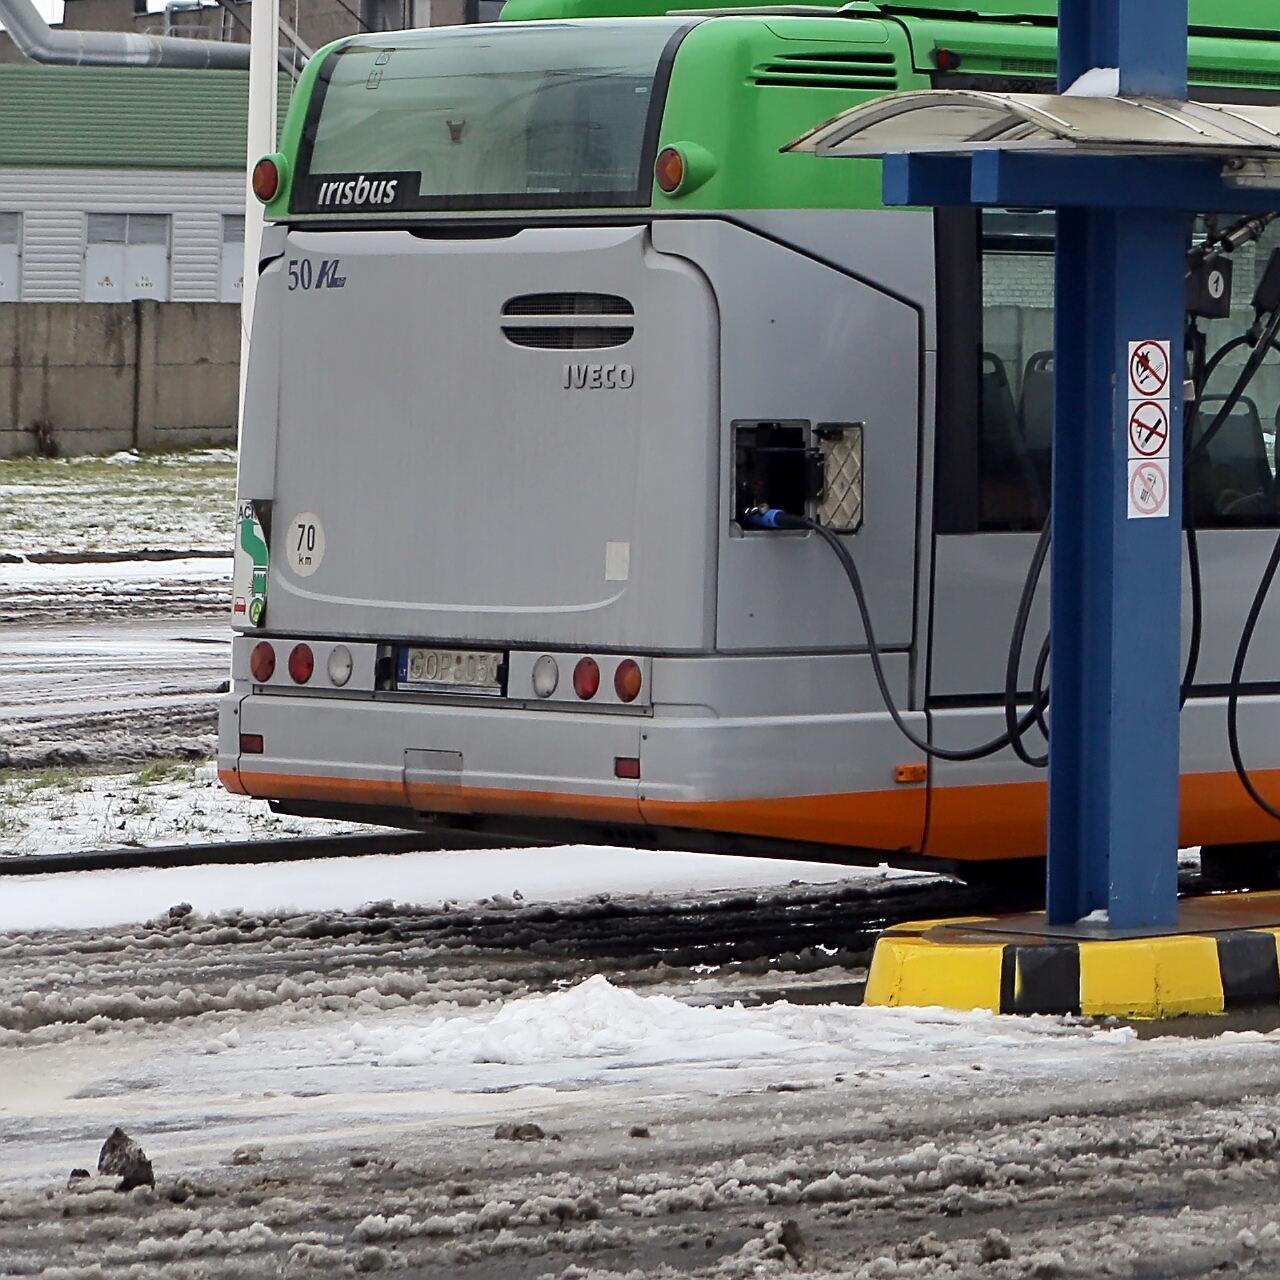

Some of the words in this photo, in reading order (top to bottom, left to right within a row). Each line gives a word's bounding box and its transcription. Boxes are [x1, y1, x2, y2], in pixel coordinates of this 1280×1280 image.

[288, 258, 312, 291] 50
[1213, 274, 1220, 293] 1
[563, 363, 635, 389] IVECO
[297, 524, 315, 551] 70
[298, 553, 312, 566] km
